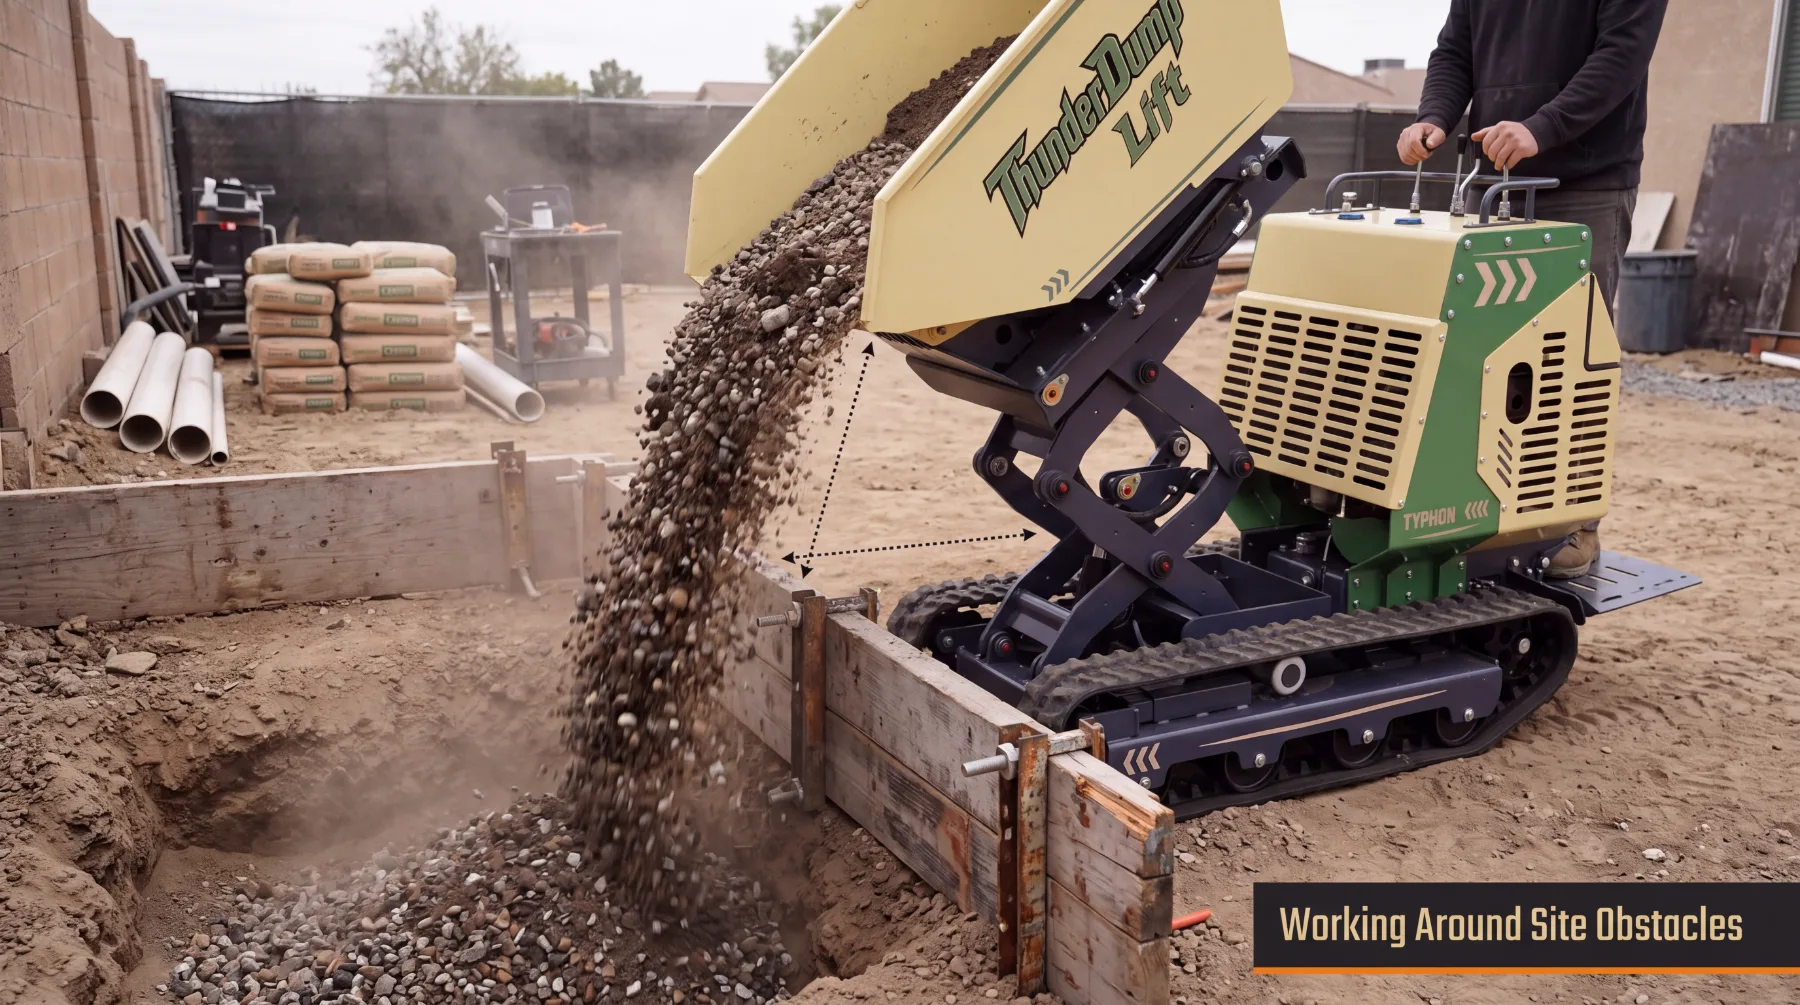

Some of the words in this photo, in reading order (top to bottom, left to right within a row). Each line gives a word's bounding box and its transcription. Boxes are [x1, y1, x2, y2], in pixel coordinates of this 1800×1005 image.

[983, 0, 1184, 239] ThunderDump
[1111, 60, 1192, 168] Lift
[1403, 506, 1456, 531] TYPHON
